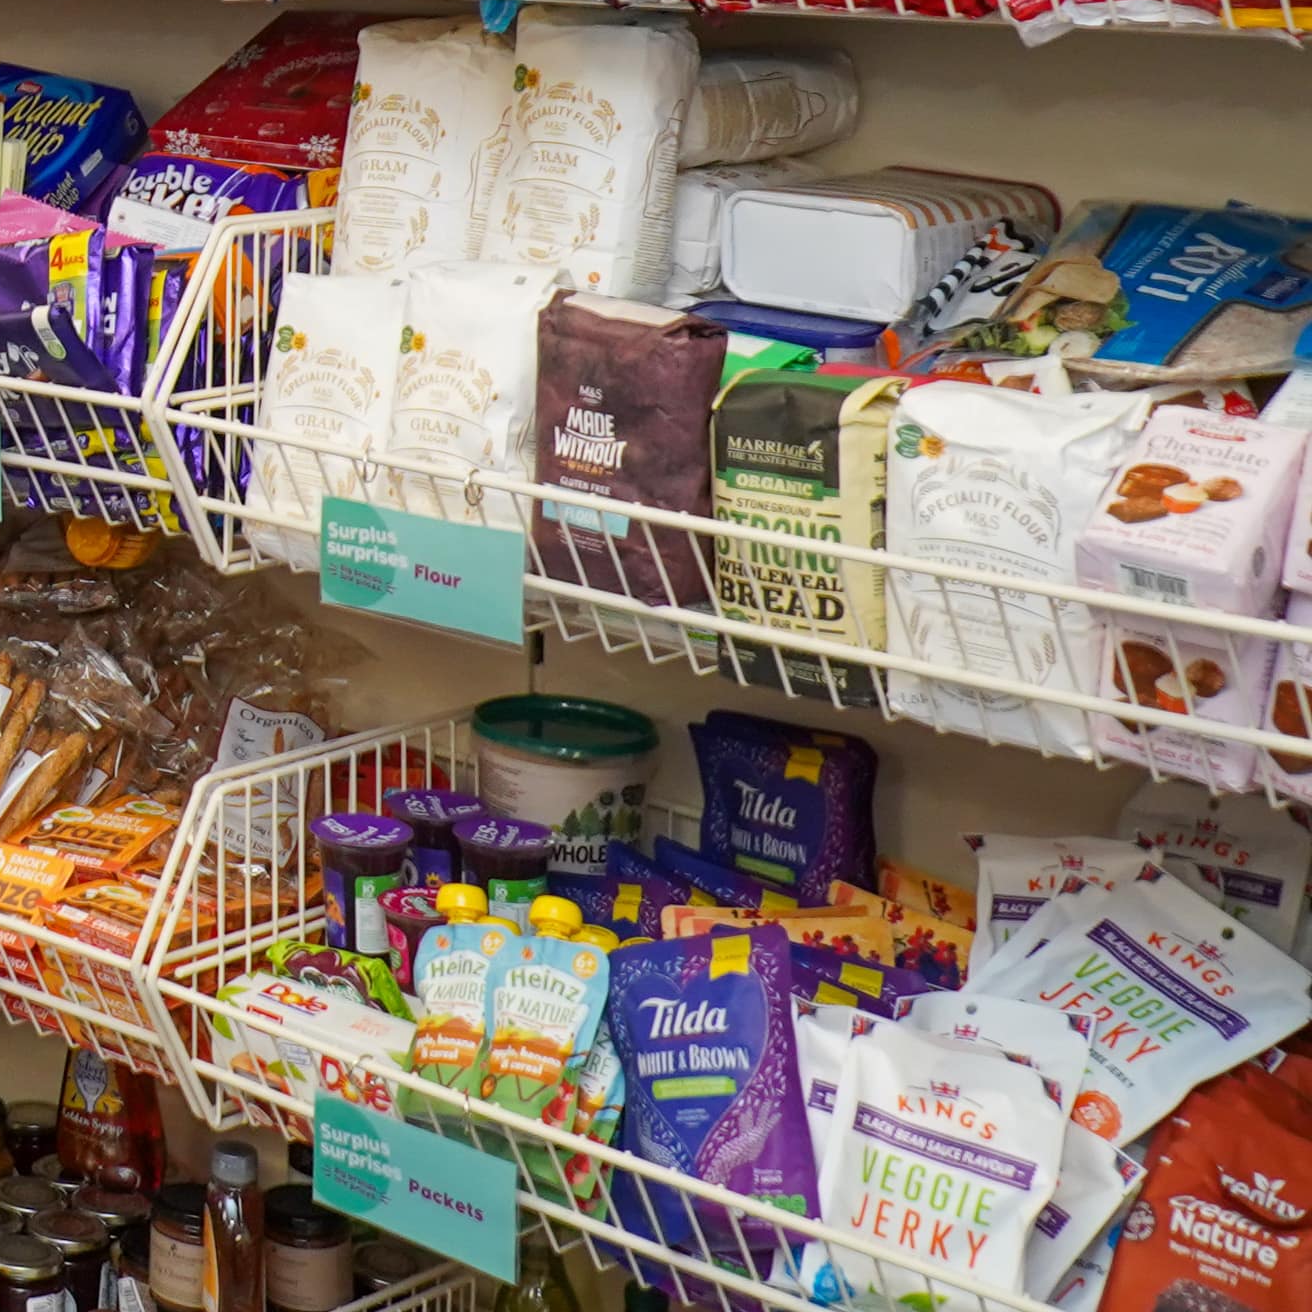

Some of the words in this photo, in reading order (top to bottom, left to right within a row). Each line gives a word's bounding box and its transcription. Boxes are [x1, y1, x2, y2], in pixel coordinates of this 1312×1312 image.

[3, 94, 106, 133] Walnut
[359, 157, 409, 176] GRAM
[531, 149, 579, 168] GRAM
[49, 247, 64, 272] 4
[1136, 232, 1249, 302] ROTI
[283, 371, 338, 398] SPECIALITY
[579, 384, 603, 400] M&S
[294, 413, 344, 434] GRAM
[410, 415, 462, 437] GRAM
[565, 405, 616, 438] MADE
[554, 425, 627, 470] WITHOUT
[1147, 434, 1271, 468] Chocolate
[559, 474, 590, 491] GLUTEN
[590, 480, 614, 496] FREE
[736, 472, 814, 497] ORGANIC
[736, 496, 812, 519] STONEGROUND
[919, 489, 1000, 525] SPECIALITY
[1002, 500, 1049, 546] FLOUR
[327, 520, 398, 547] Surplus
[716, 505, 842, 575] STRONG
[327, 540, 410, 570] surprises
[414, 563, 463, 589] Flour
[718, 555, 845, 593] WHOLEMEAL
[719, 574, 846, 622] BREAD
[238, 707, 315, 740] Organico
[732, 778, 799, 830] Tilda
[31, 819, 137, 848] graze
[1152, 832, 1251, 866] KINGS
[3, 861, 56, 887] BARBECUE
[10, 852, 50, 871] SMOKY
[429, 954, 486, 979] Heinz
[1146, 931, 1235, 998] KINGS
[262, 982, 328, 1013] Dole
[432, 979, 486, 1002] NATURE
[510, 969, 582, 1003] Heinz
[1074, 951, 1196, 1043] VEGGIE
[496, 990, 515, 1014] BY
[517, 997, 582, 1025] NATURE
[638, 996, 729, 1039] Tilda
[528, 1049, 562, 1069] banana
[638, 1050, 676, 1077] WHITE
[689, 1043, 751, 1073] BROWN
[896, 1092, 999, 1141] KINGS
[319, 1122, 391, 1158] Surplus
[861, 1111, 891, 1136] BLACK
[892, 1124, 925, 1149] BEAN
[926, 1135, 962, 1162] SAUCE
[962, 1147, 1016, 1179] FLAVOUR
[319, 1140, 403, 1181] surprises
[408, 1177, 485, 1223] Packets
[861, 1144, 999, 1228] VEGGIE
[850, 1192, 990, 1271] JERKY
[1169, 1207, 1280, 1269] Nature
